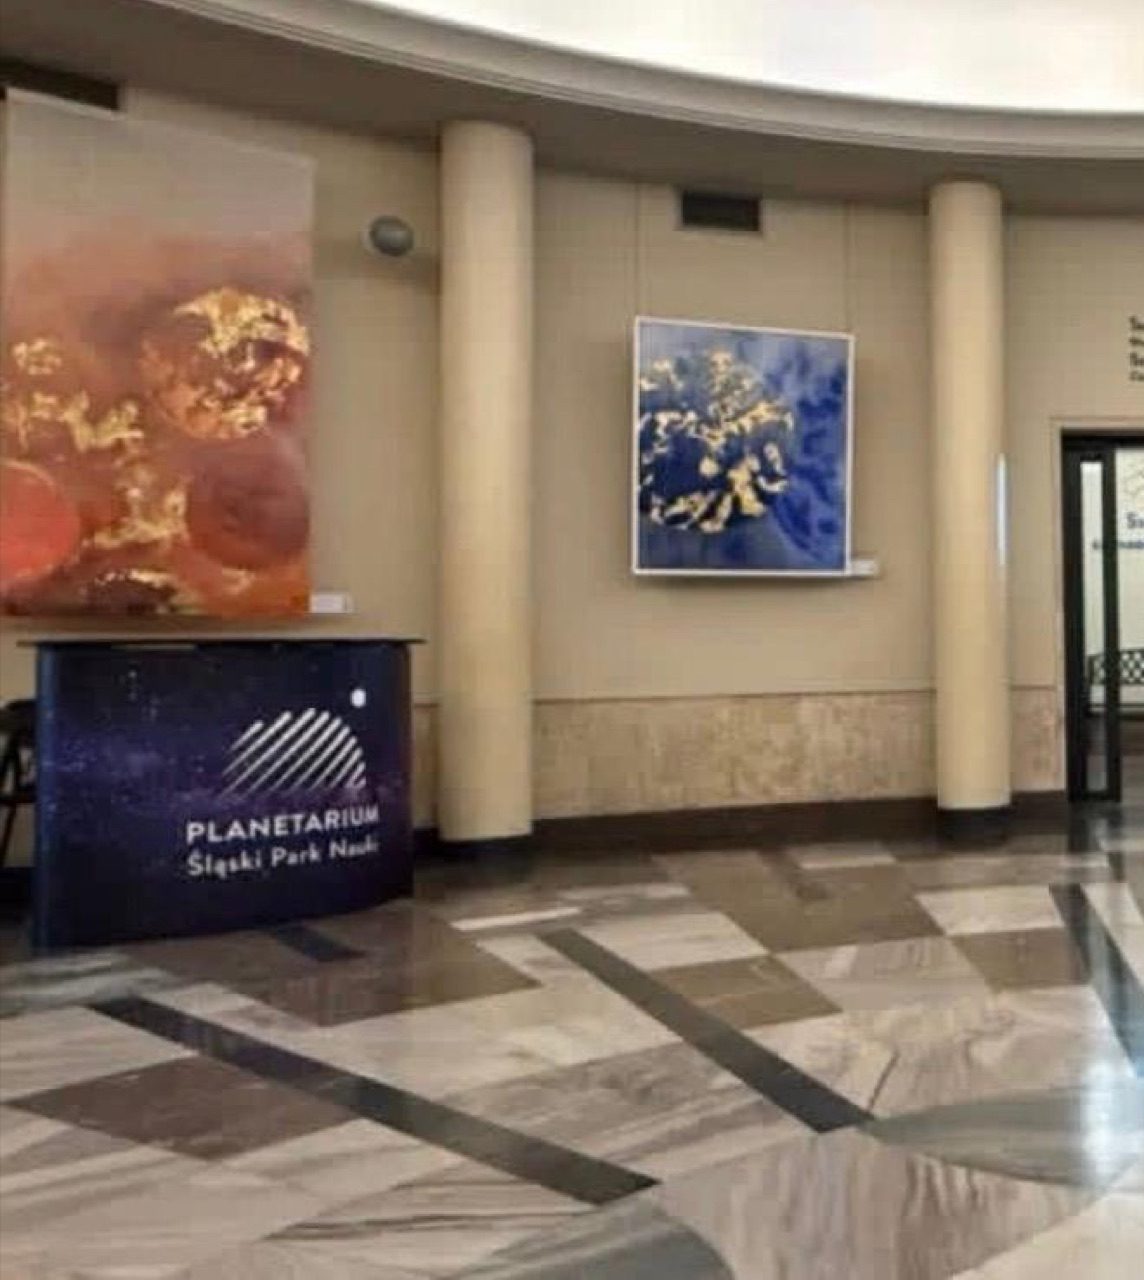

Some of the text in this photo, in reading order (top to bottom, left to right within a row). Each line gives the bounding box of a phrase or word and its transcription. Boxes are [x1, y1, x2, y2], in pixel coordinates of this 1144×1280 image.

[186, 803, 379, 845] PLANETARIUM
[187, 848, 262, 879] Śląski
[270, 842, 321, 867] Park
